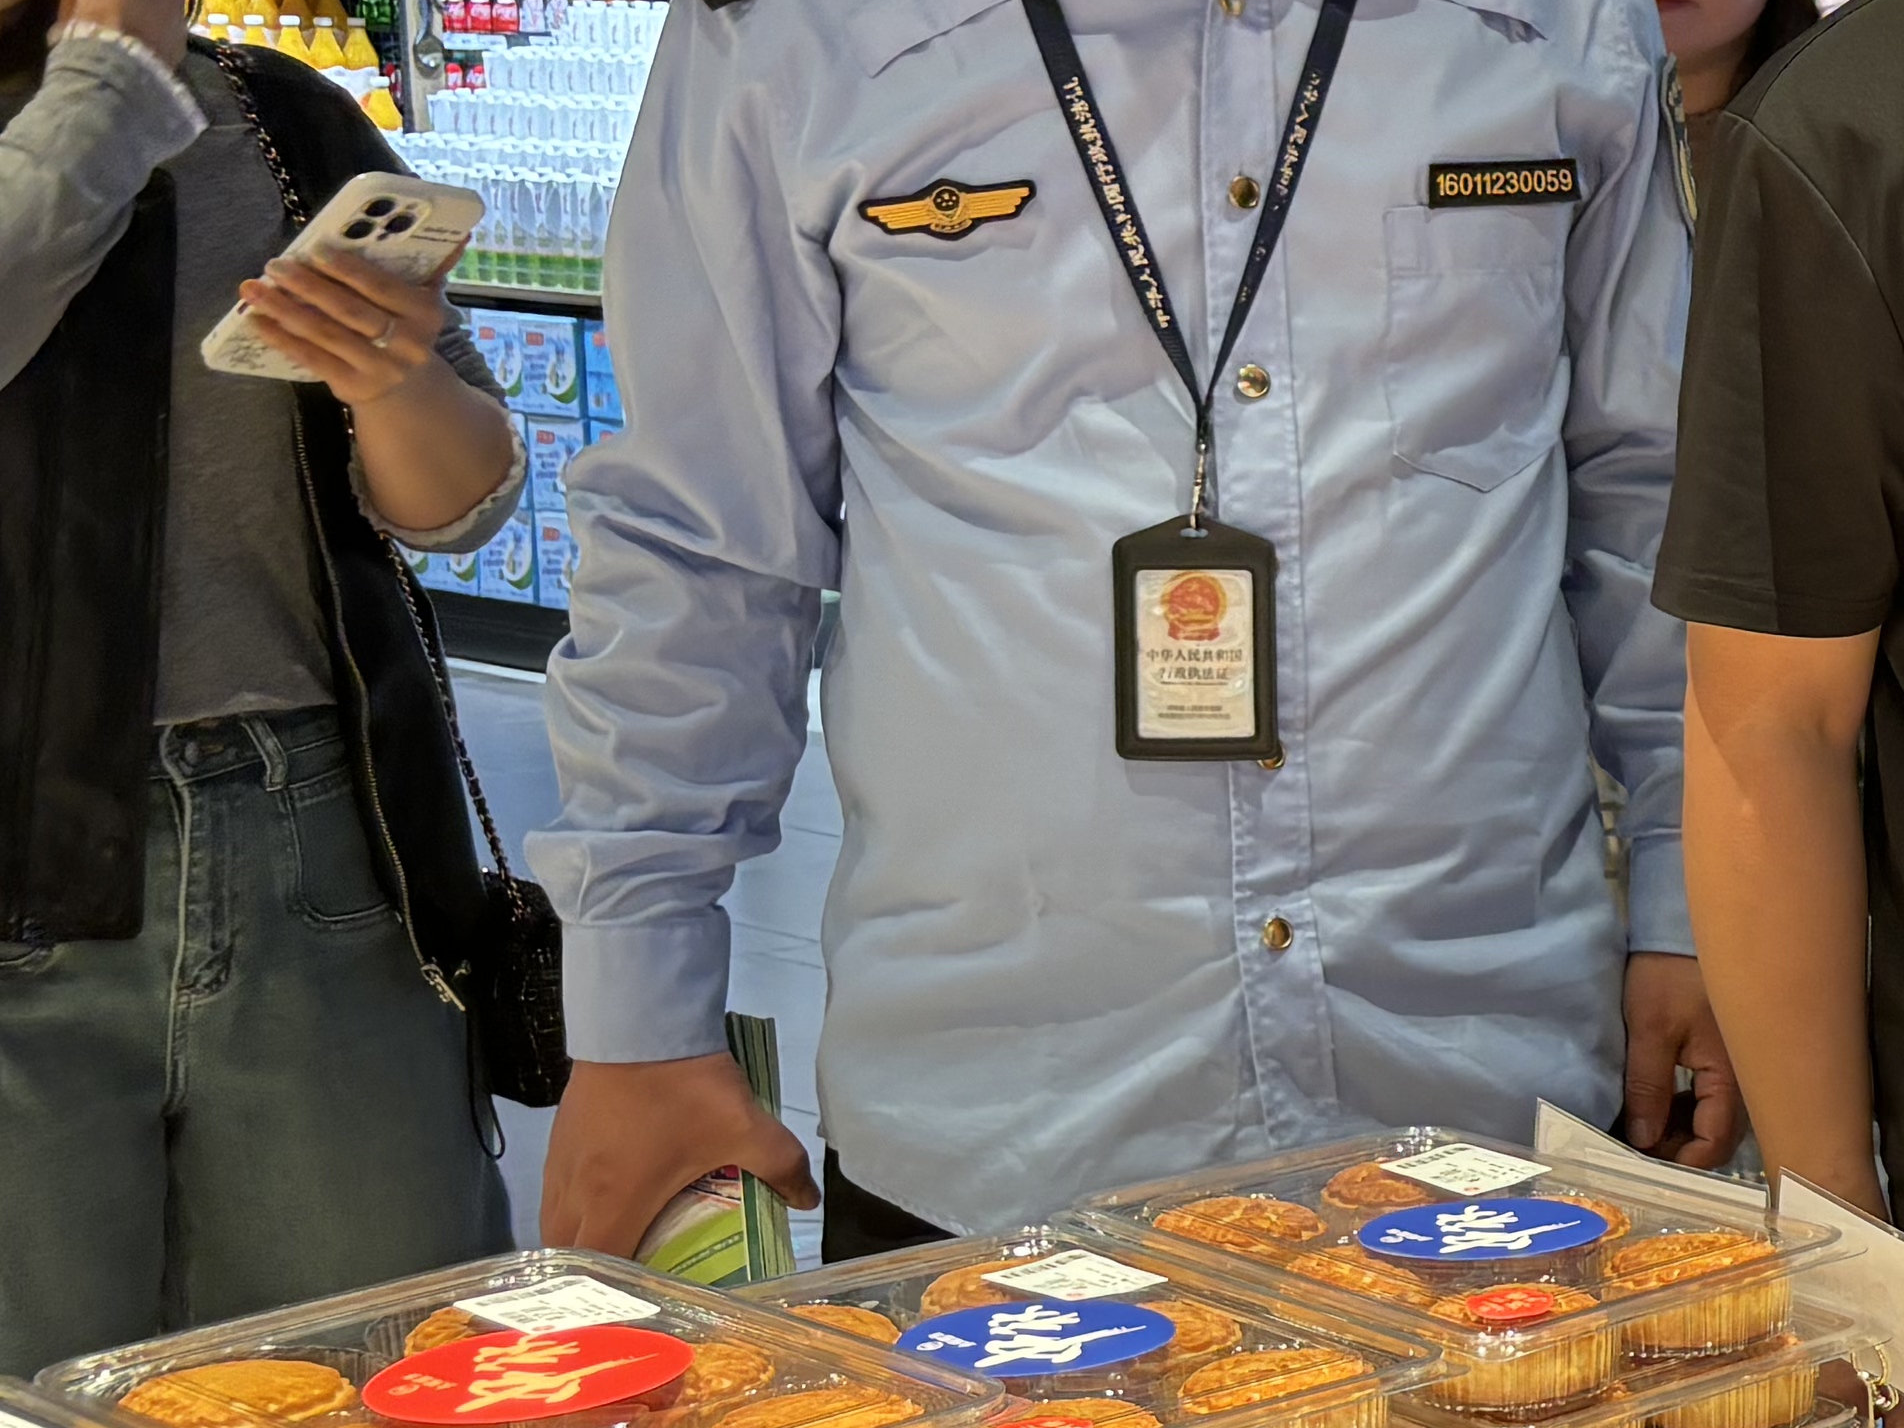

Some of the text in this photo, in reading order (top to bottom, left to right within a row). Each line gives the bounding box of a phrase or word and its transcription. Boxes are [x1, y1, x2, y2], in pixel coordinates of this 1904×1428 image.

[1435, 169, 1573, 197] 16011230059
[1146, 649, 1243, 662] 中华人民共和国
